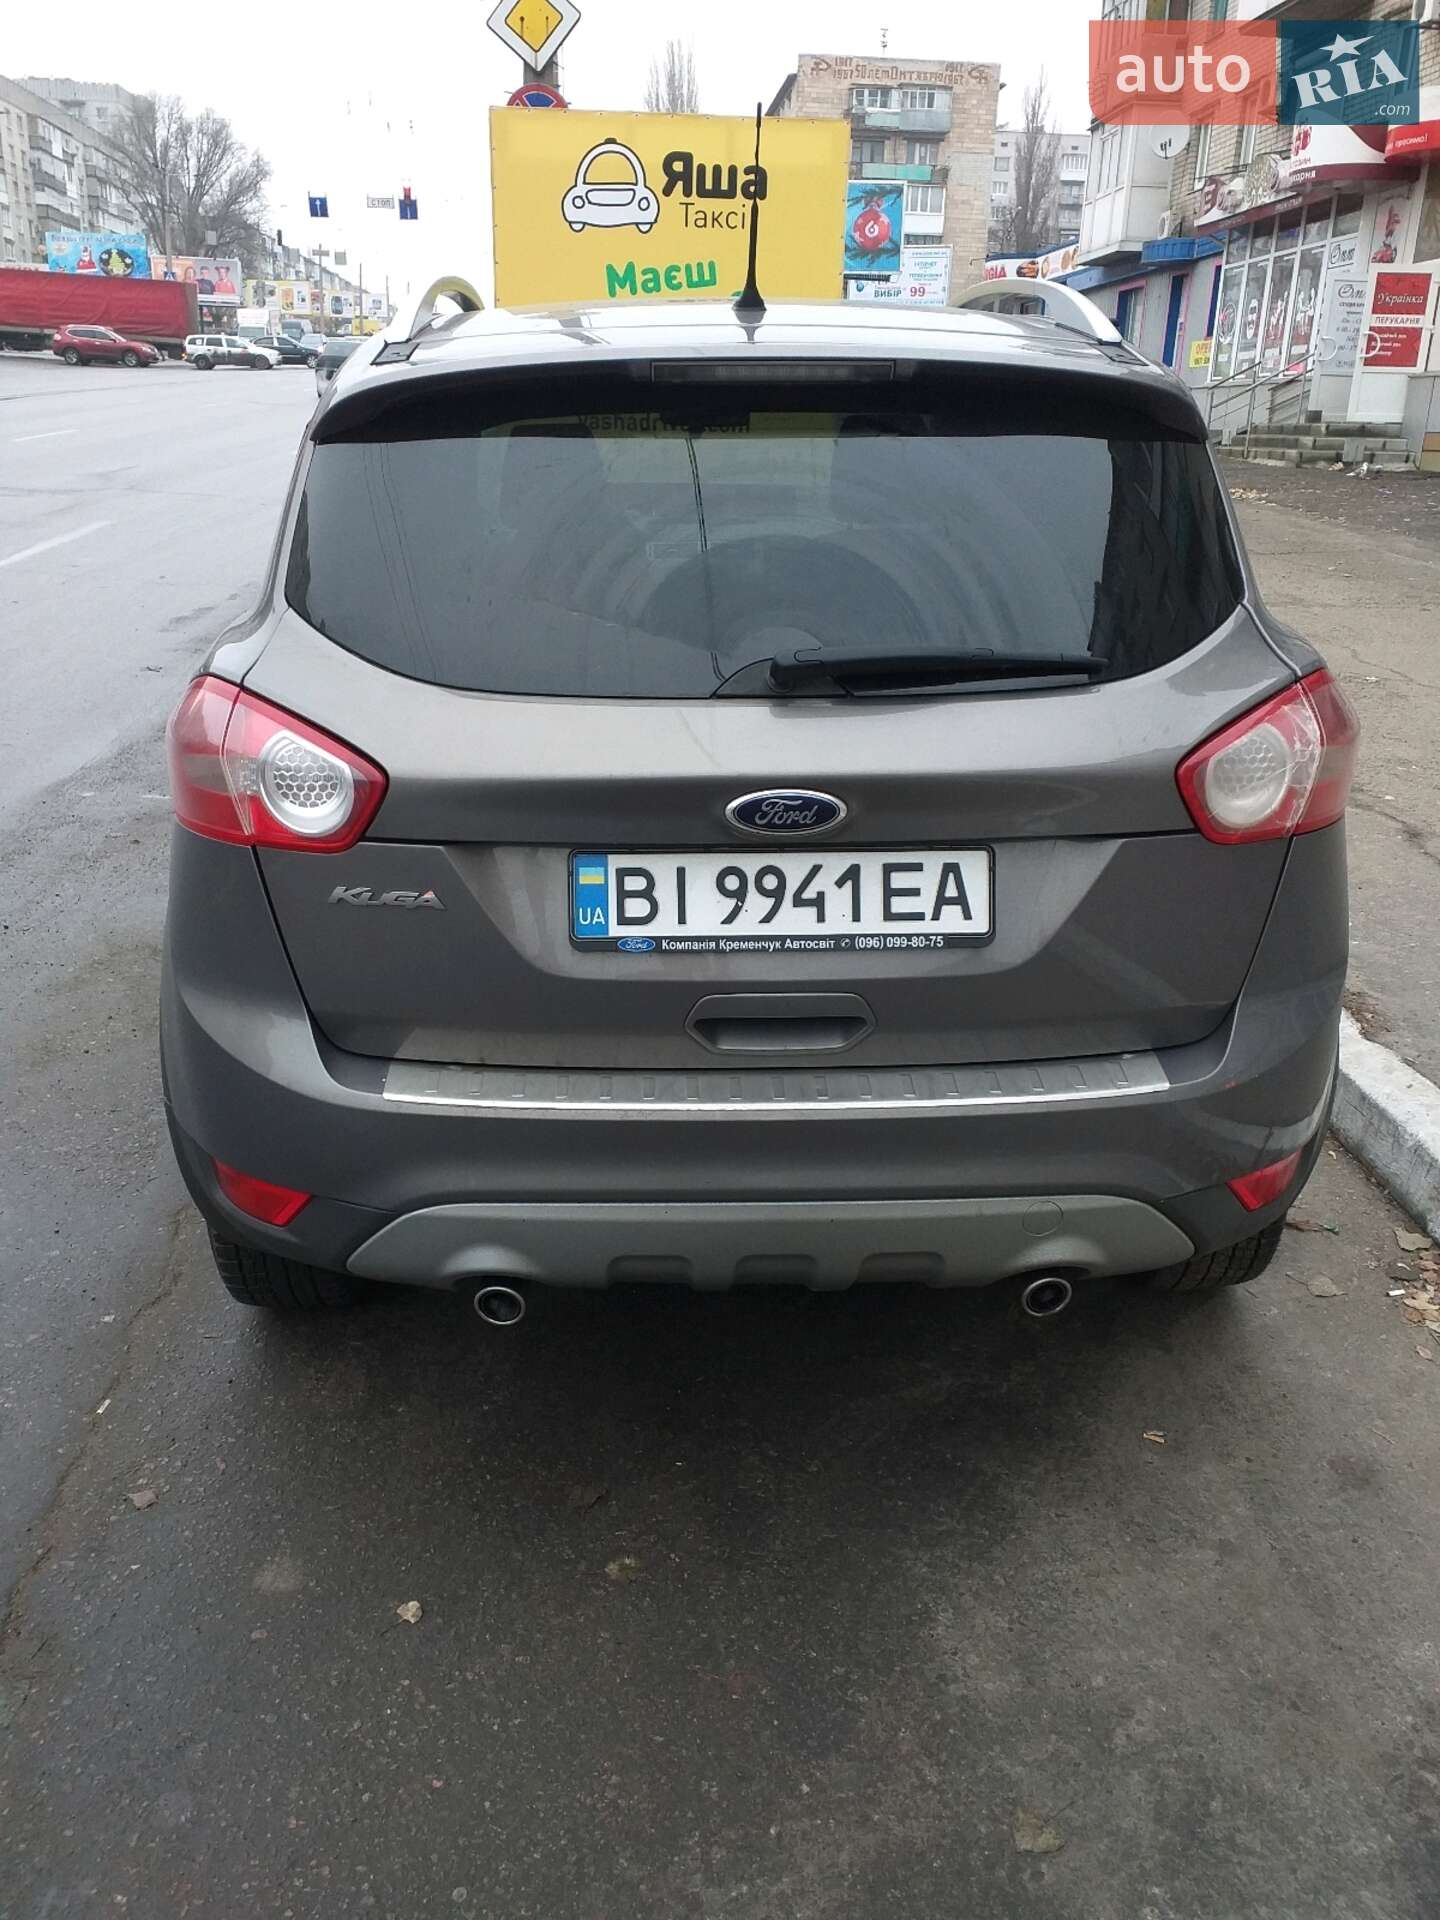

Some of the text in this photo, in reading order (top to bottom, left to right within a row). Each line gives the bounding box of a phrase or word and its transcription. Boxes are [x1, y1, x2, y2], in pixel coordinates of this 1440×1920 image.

[662, 151, 768, 200] Яша
[679, 202, 746, 229] Таксі
[605, 260, 717, 298] Маєш
[910, 286, 926, 297] 99
[755, 799, 818, 825] Ford
[616, 862, 972, 925] BI 9941 EA
[579, 907, 605, 925] UA
[661, 935, 944, 952] Компанія Кременчук Автосвіт (096) 099-80-75
